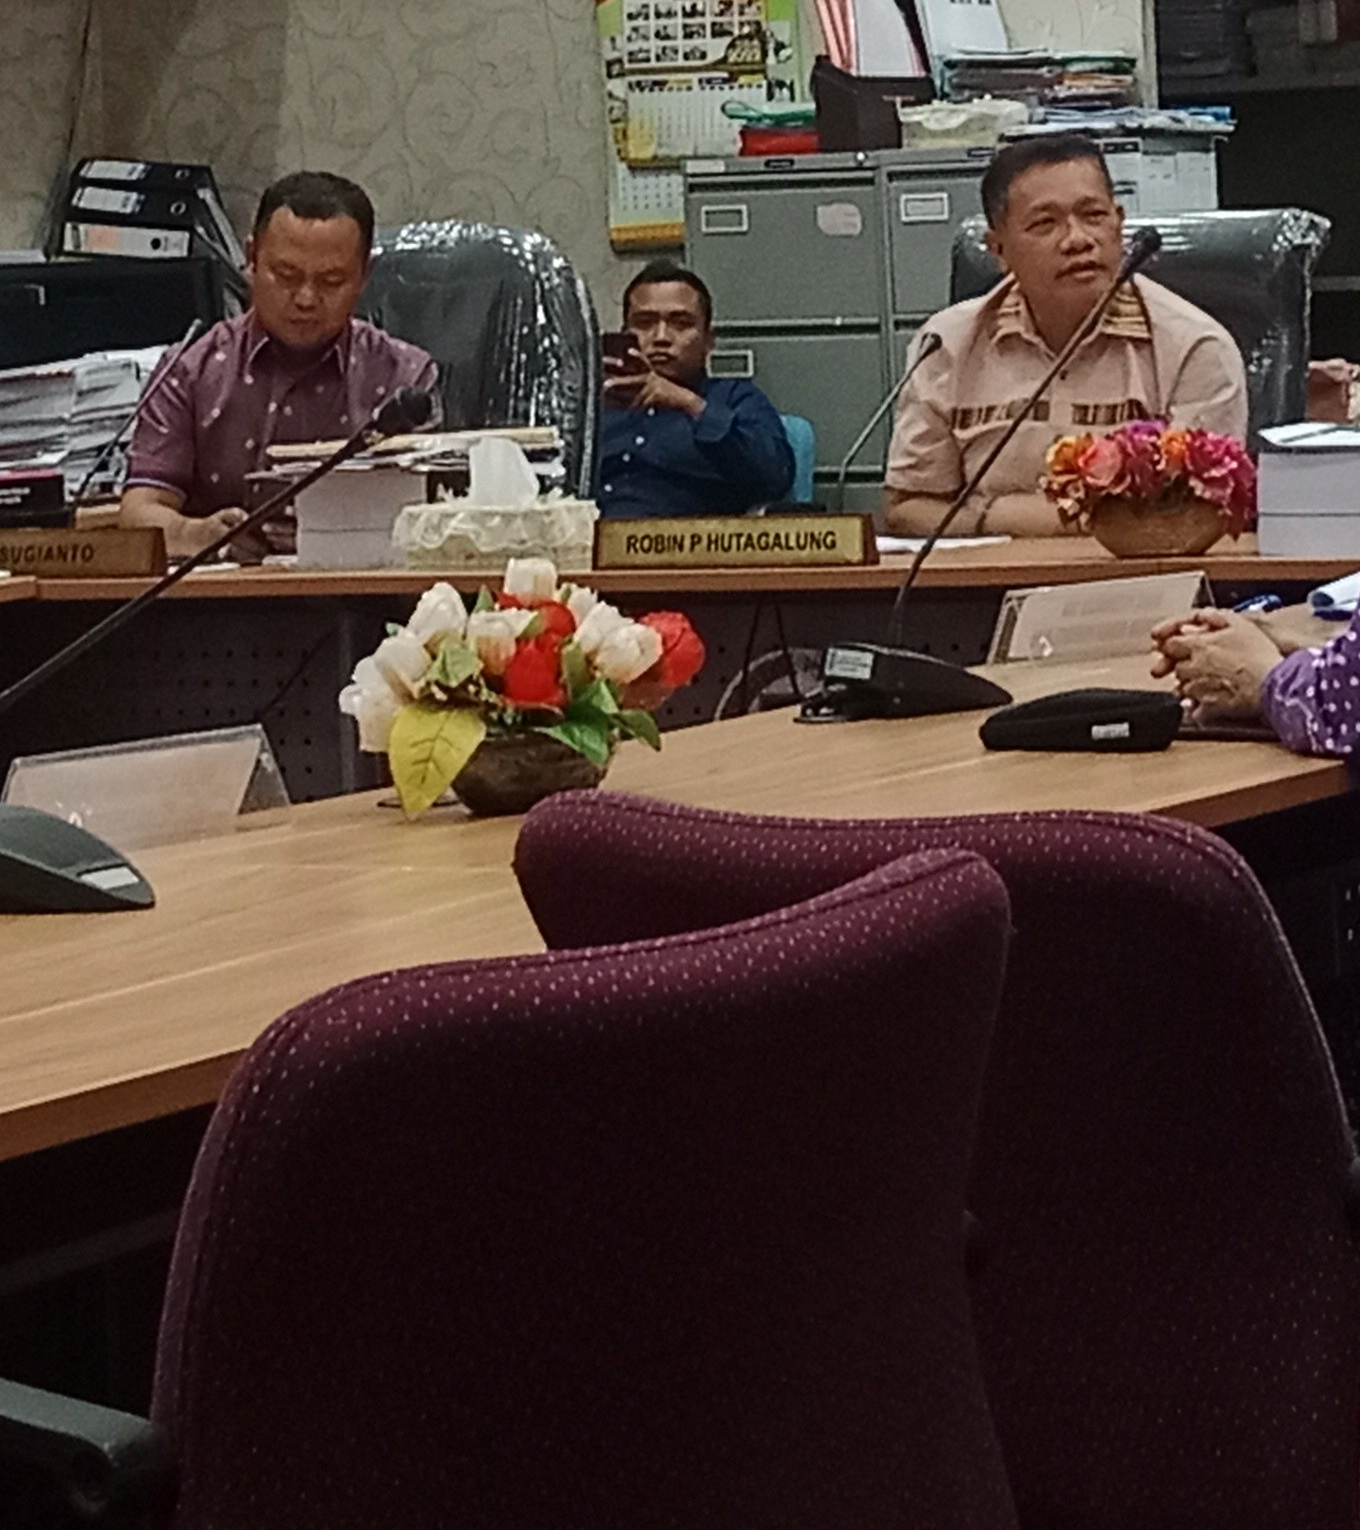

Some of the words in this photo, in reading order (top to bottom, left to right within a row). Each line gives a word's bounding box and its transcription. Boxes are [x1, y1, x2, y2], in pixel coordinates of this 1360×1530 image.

[626, 534, 685, 554] ROBIN
[690, 533, 703, 553] P
[706, 531, 837, 553] HUTAGALUNG
[0, 545, 95, 565] SUGIANTO
